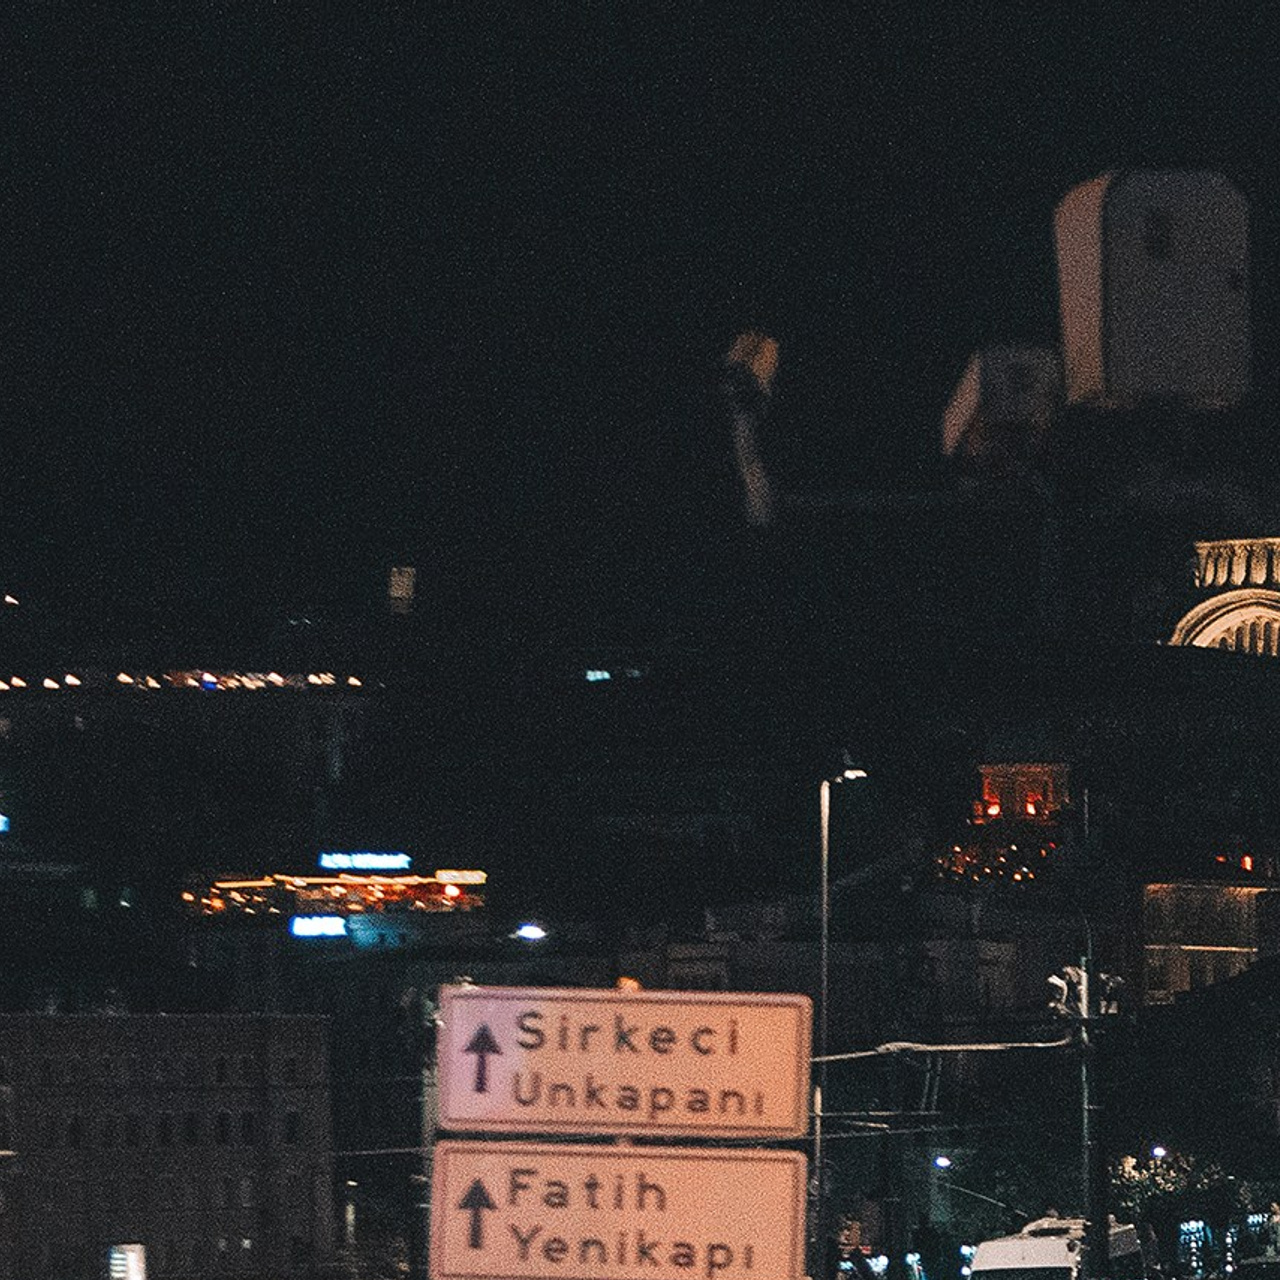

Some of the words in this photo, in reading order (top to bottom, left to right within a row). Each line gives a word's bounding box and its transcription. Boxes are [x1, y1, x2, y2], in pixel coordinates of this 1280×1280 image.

[517, 1009, 739, 1056] Sirkeci
[512, 1073, 765, 1120] Unkapanı
[508, 1168, 667, 1213] Fatih
[507, 1223, 754, 1278] Yenikapı
